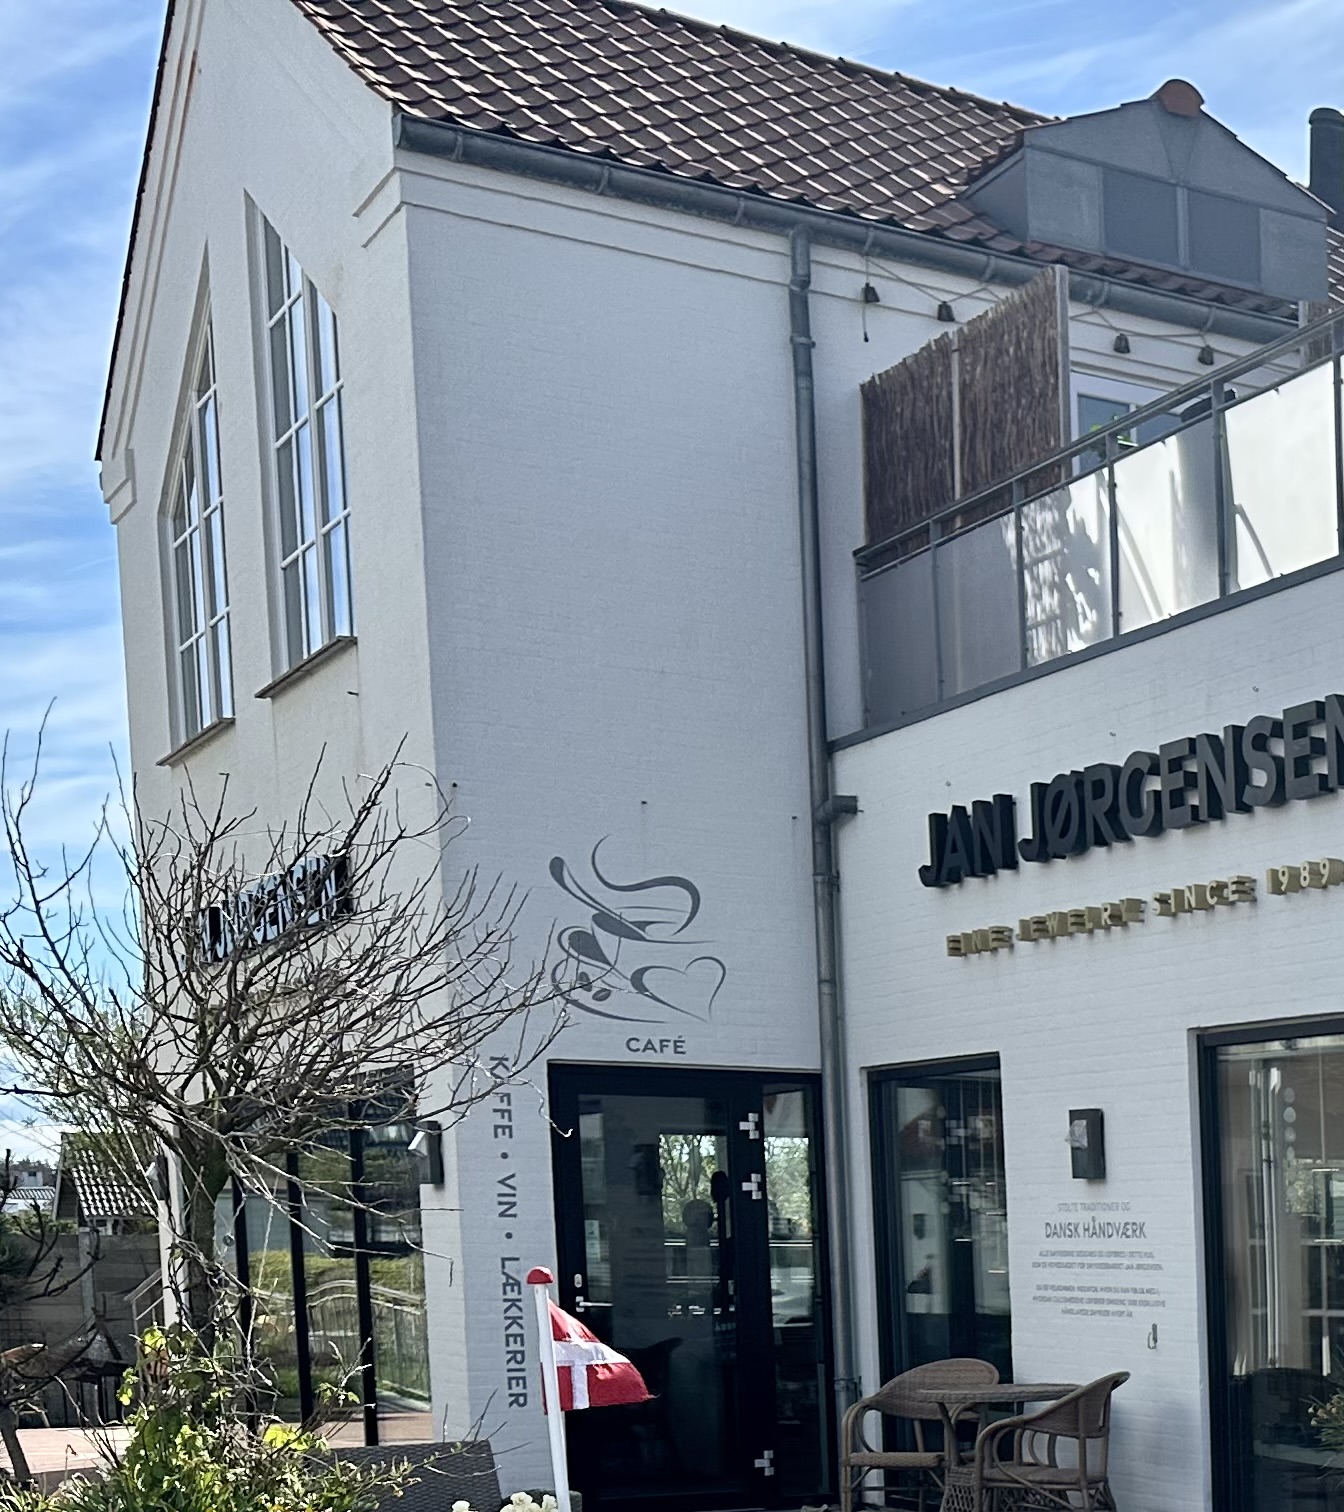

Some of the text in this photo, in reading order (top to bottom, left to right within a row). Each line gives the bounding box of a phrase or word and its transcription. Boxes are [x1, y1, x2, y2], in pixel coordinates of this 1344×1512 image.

[919, 793, 1020, 888] JAN
[946, 926, 1014, 957] FINE
[1015, 897, 1148, 942] JEWELRY
[1151, 874, 1258, 918] SINCE
[626, 1034, 687, 1055] CAFÉ
[496, 1172, 517, 1218] VIN
[1044, 1215, 1147, 1239] DANSK HÅNDVÆRK
[501, 1256, 528, 1409] LÆKKERIER
